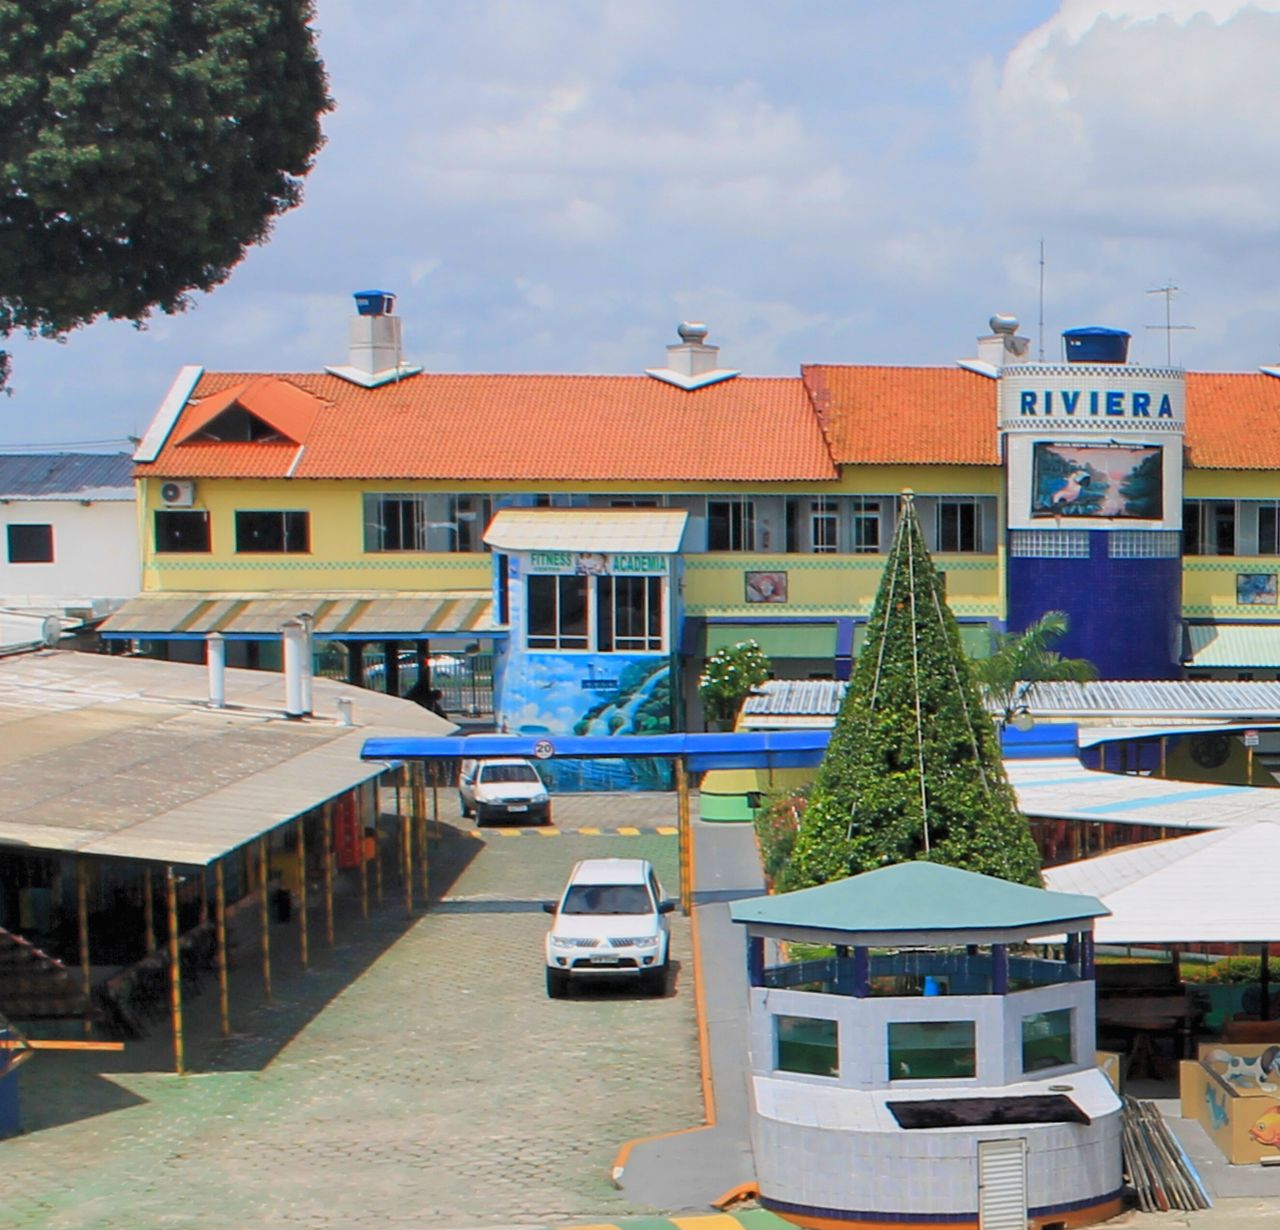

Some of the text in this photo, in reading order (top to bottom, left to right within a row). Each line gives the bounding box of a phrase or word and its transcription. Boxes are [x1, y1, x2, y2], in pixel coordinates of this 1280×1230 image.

[1020, 390, 1173, 418] RIVIERA
[530, 552, 573, 567] FITNESS
[613, 555, 667, 572] ACADEMIA
[536, 743, 552, 753] 20
